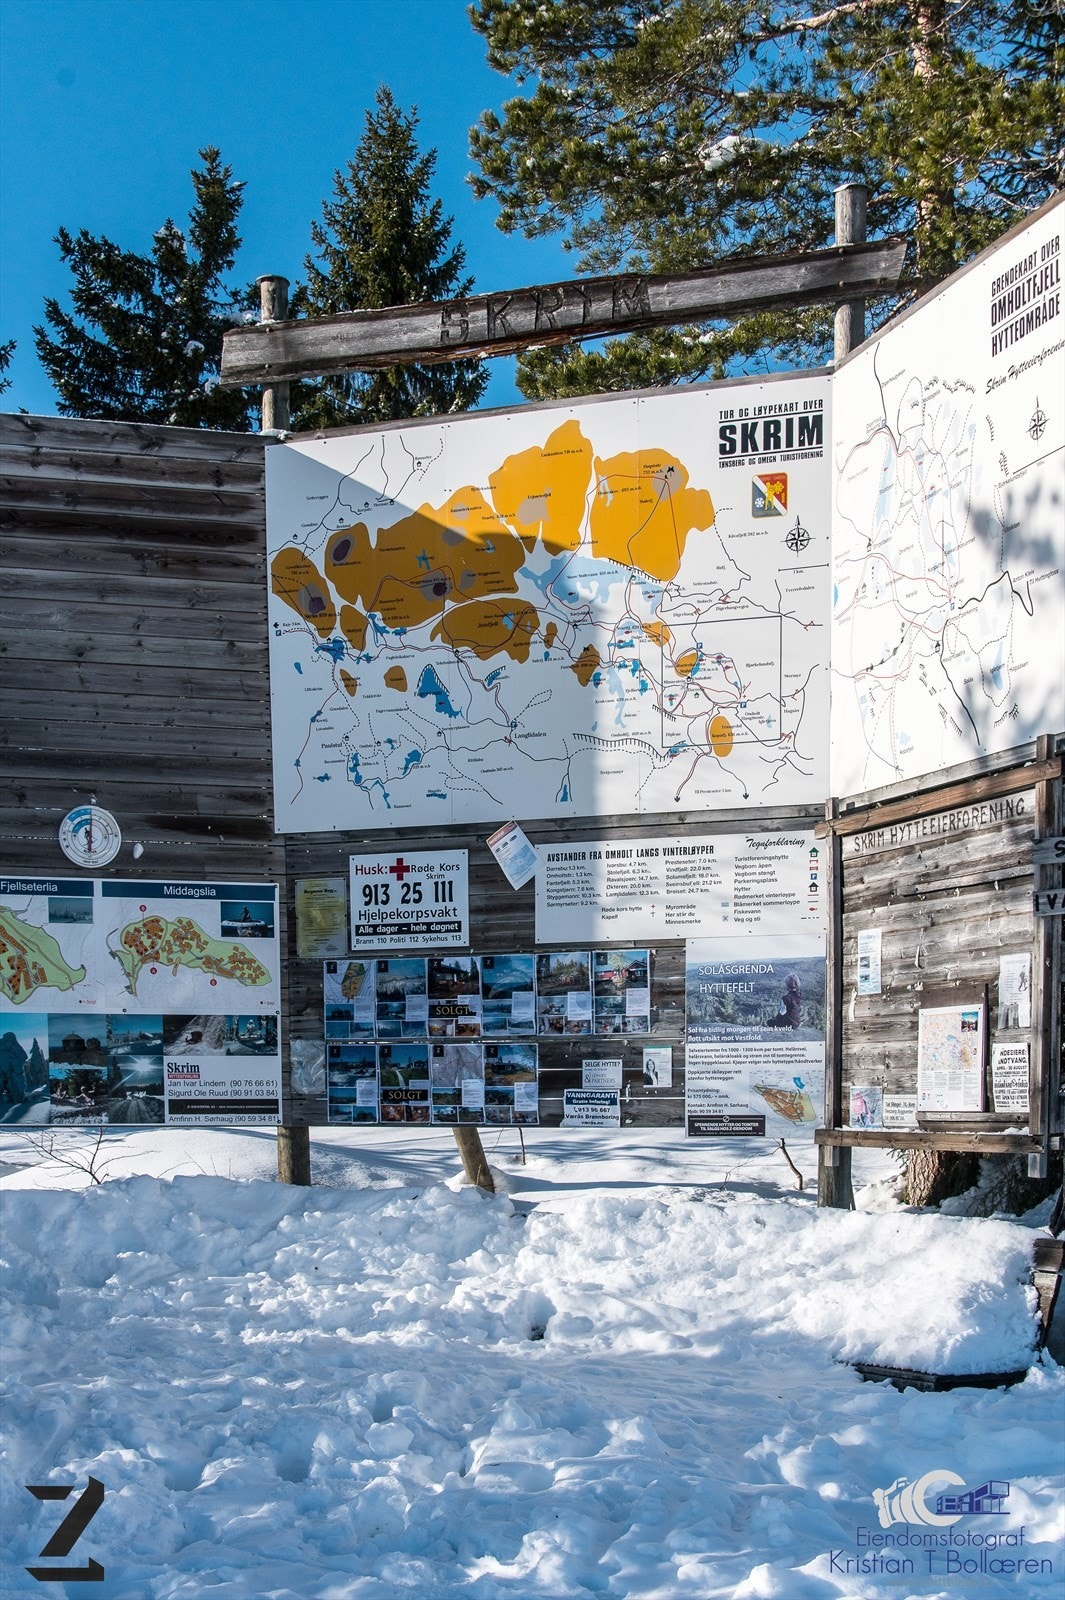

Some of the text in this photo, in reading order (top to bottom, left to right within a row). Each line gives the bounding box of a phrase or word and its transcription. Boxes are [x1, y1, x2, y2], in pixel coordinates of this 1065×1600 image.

[992, 235, 1060, 297] GRENDEKART OVER
[991, 259, 1061, 327] OMHOLTFJELL
[439, 278, 652, 347] SKRIM
[991, 292, 1060, 358] HYTTEOMRÅDE
[986, 374, 1007, 394] Skrim
[719, 399, 823, 420] TUR OG LØYPEKART OVER
[719, 414, 823, 456] SKRIM
[719, 458, 745, 468] TØNSBERG
[758, 456, 776, 464] OMEGN
[780, 450, 823, 462] TURISTFORENING
[854, 797, 1025, 852] SKRIM HYTTEEIERFORENING
[746, 838, 805, 850] Tegnforklaring
[547, 845, 714, 862] AVSTANDER FRA OMHOLT LANGS VINTERLØYPER
[355, 863, 460, 876] Husk: Røde Kors
[0, 881, 58, 892] Fjellseterlia
[164, 886, 216, 897] Middagslia
[362, 880, 454, 906] 913 25 111
[358, 906, 458, 924] Hjelpekorpsvakt
[358, 922, 458, 934] Alle dager hele døgnet
[422, 935, 448, 944] Sykehus
[698, 963, 774, 976] SOLÅSGRENDA
[700, 982, 755, 993] HYTTEFELT
[436, 1006, 469, 1015] SOLGT
[167, 1062, 200, 1074] Skrim
[168, 1090, 192, 1098] Sigurd
[388, 1090, 422, 1100] SOLGT
